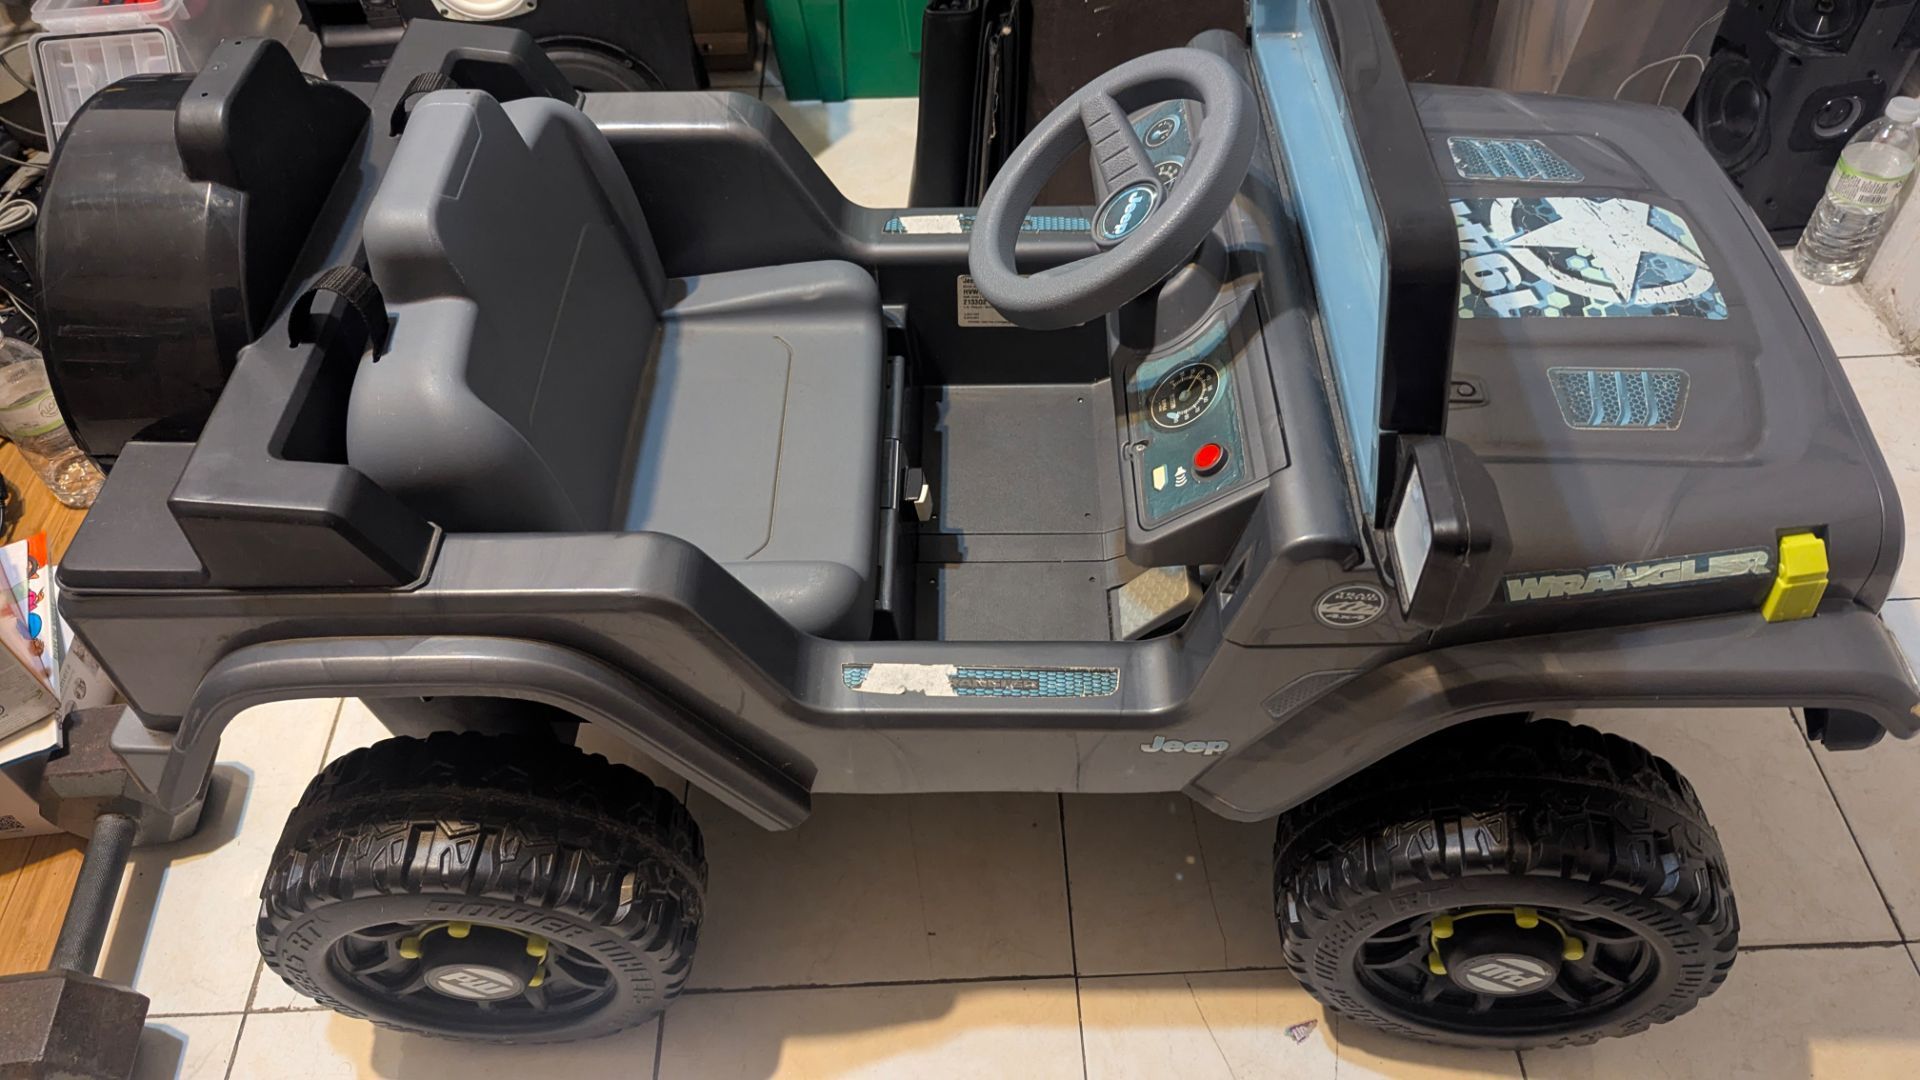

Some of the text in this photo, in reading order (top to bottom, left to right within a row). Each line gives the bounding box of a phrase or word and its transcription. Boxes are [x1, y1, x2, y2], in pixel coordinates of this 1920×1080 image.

[1114, 191, 1143, 235] Jeep
[1506, 550, 1771, 601] WRANGLER
[1140, 735, 1230, 756] Jeep
[437, 970, 513, 996] PW
[1469, 963, 1544, 988] PW
